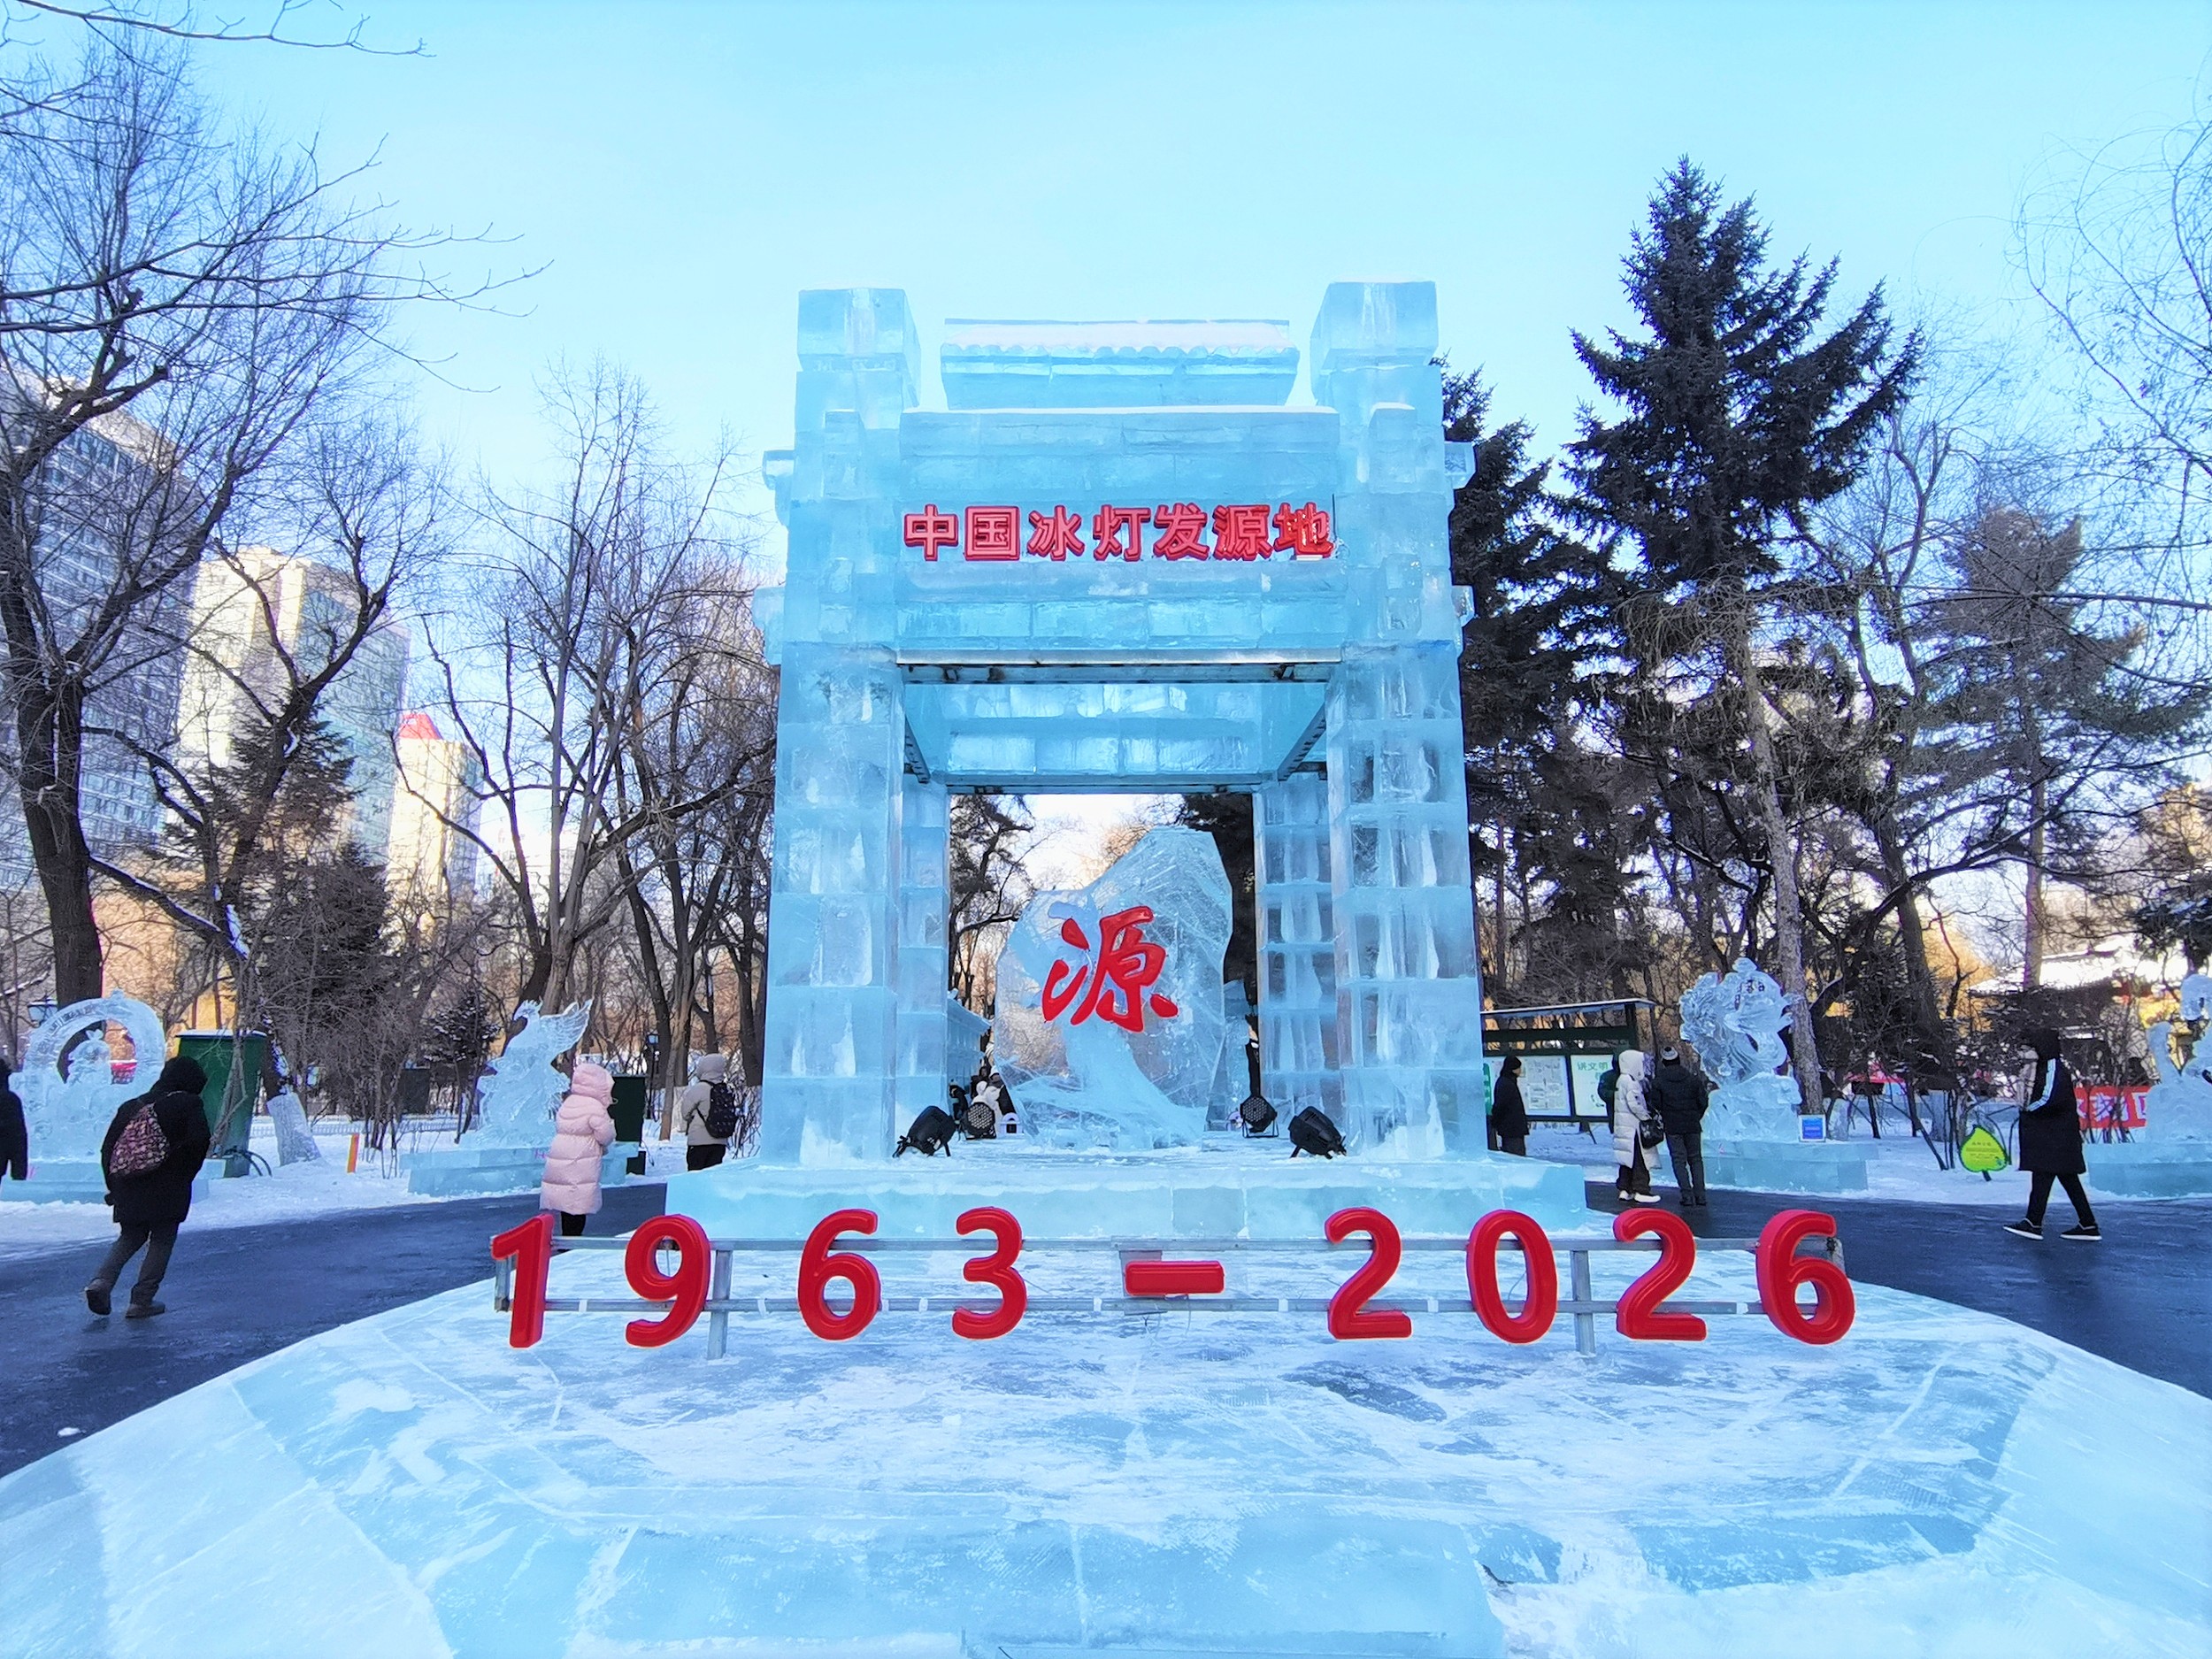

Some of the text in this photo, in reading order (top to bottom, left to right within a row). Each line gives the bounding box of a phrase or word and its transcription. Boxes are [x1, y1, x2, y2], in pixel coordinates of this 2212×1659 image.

[903, 503, 1335, 562] 中国冰灯发源地
[1041, 905, 1179, 1033] 源
